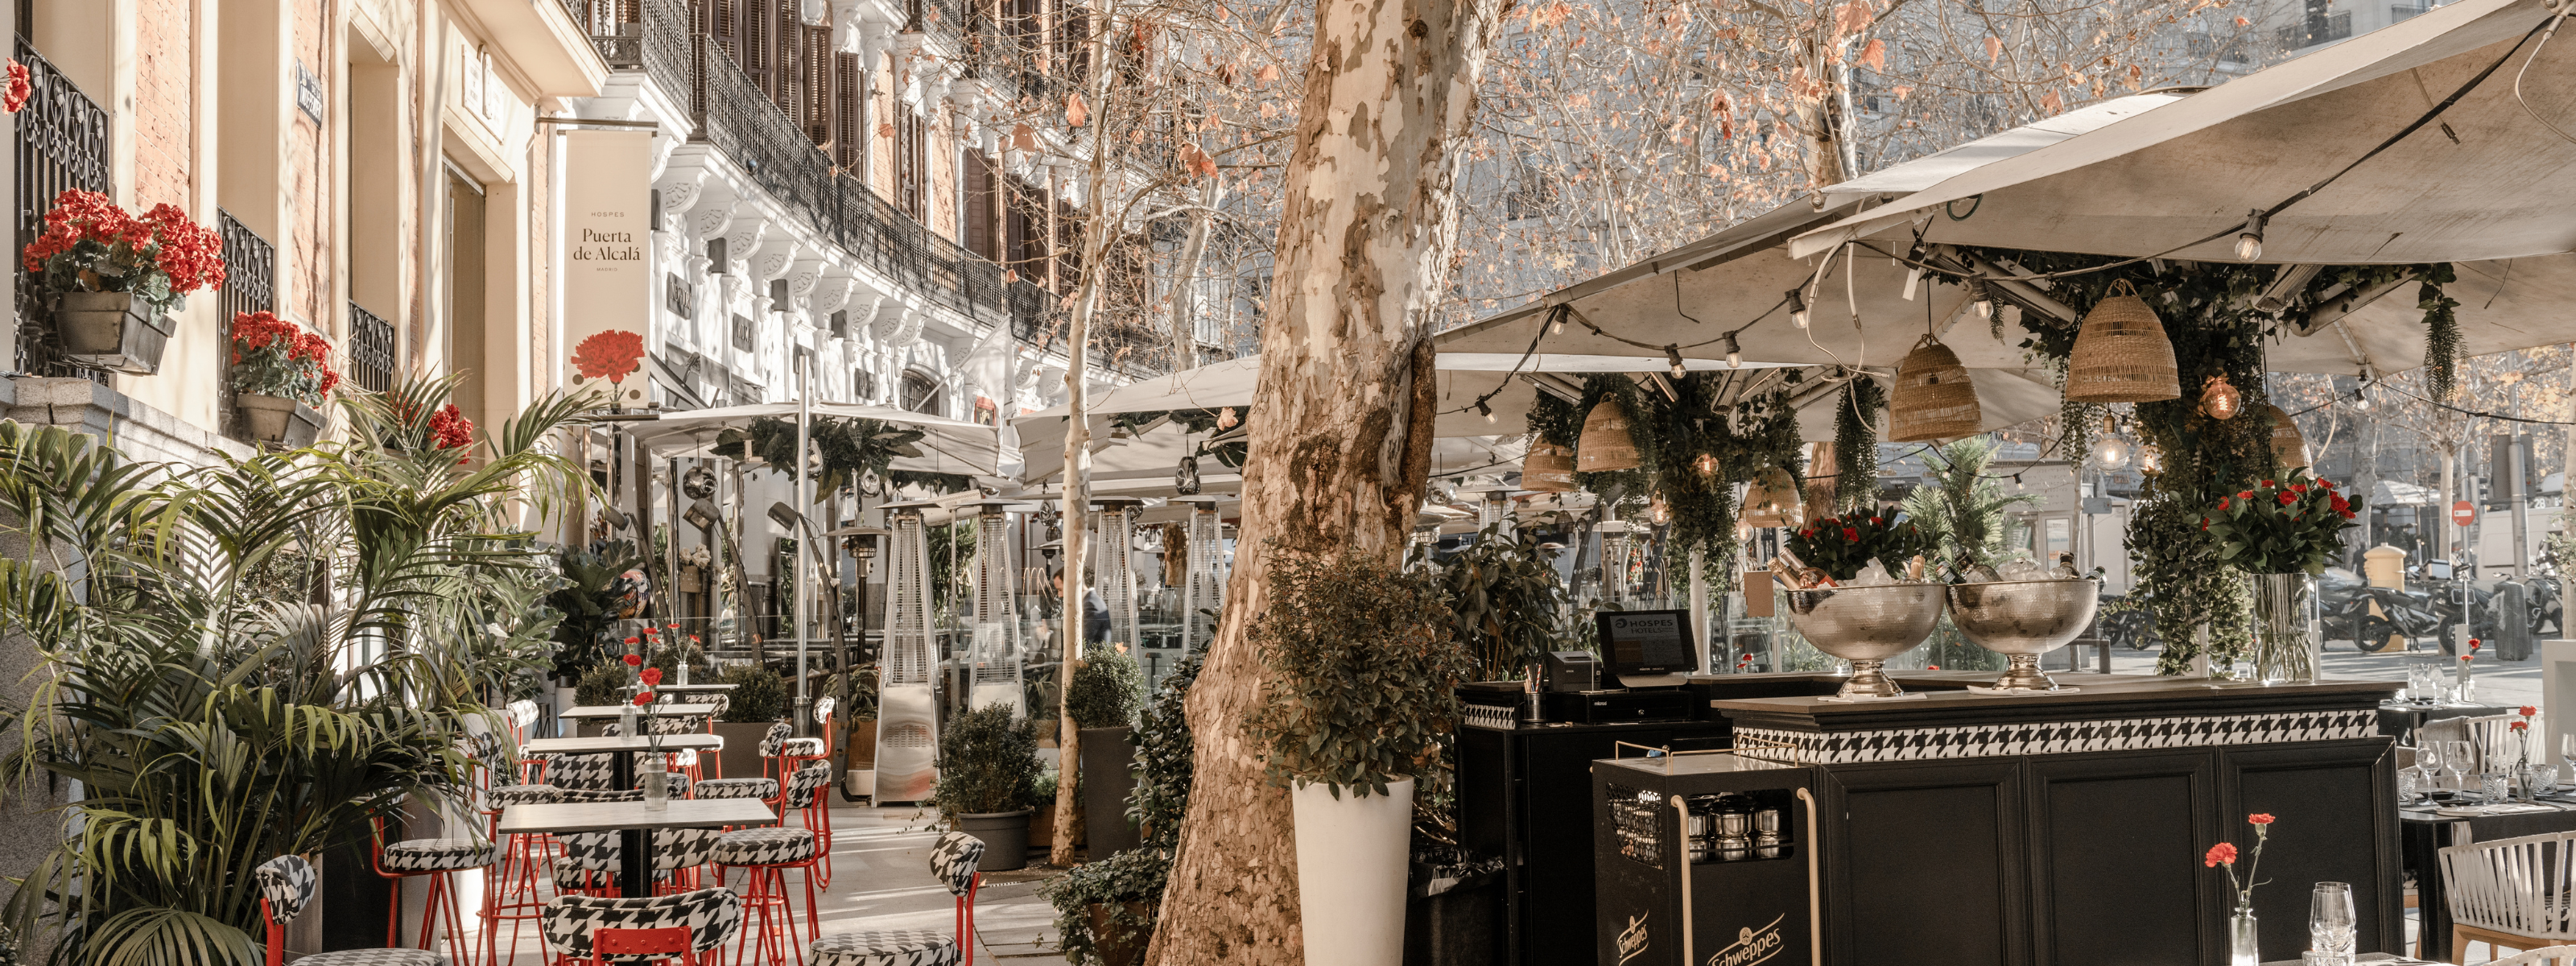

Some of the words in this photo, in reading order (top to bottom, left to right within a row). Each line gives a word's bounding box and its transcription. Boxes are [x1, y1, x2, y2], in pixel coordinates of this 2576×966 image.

[583, 228, 632, 242] Puerta
[573, 246, 592, 260] de
[596, 246, 640, 260] Alcalá
[2533, 497, 2545, 509] 28
[1629, 619, 1673, 627] HOSPES
[1619, 923, 1648, 958] Schweppes
